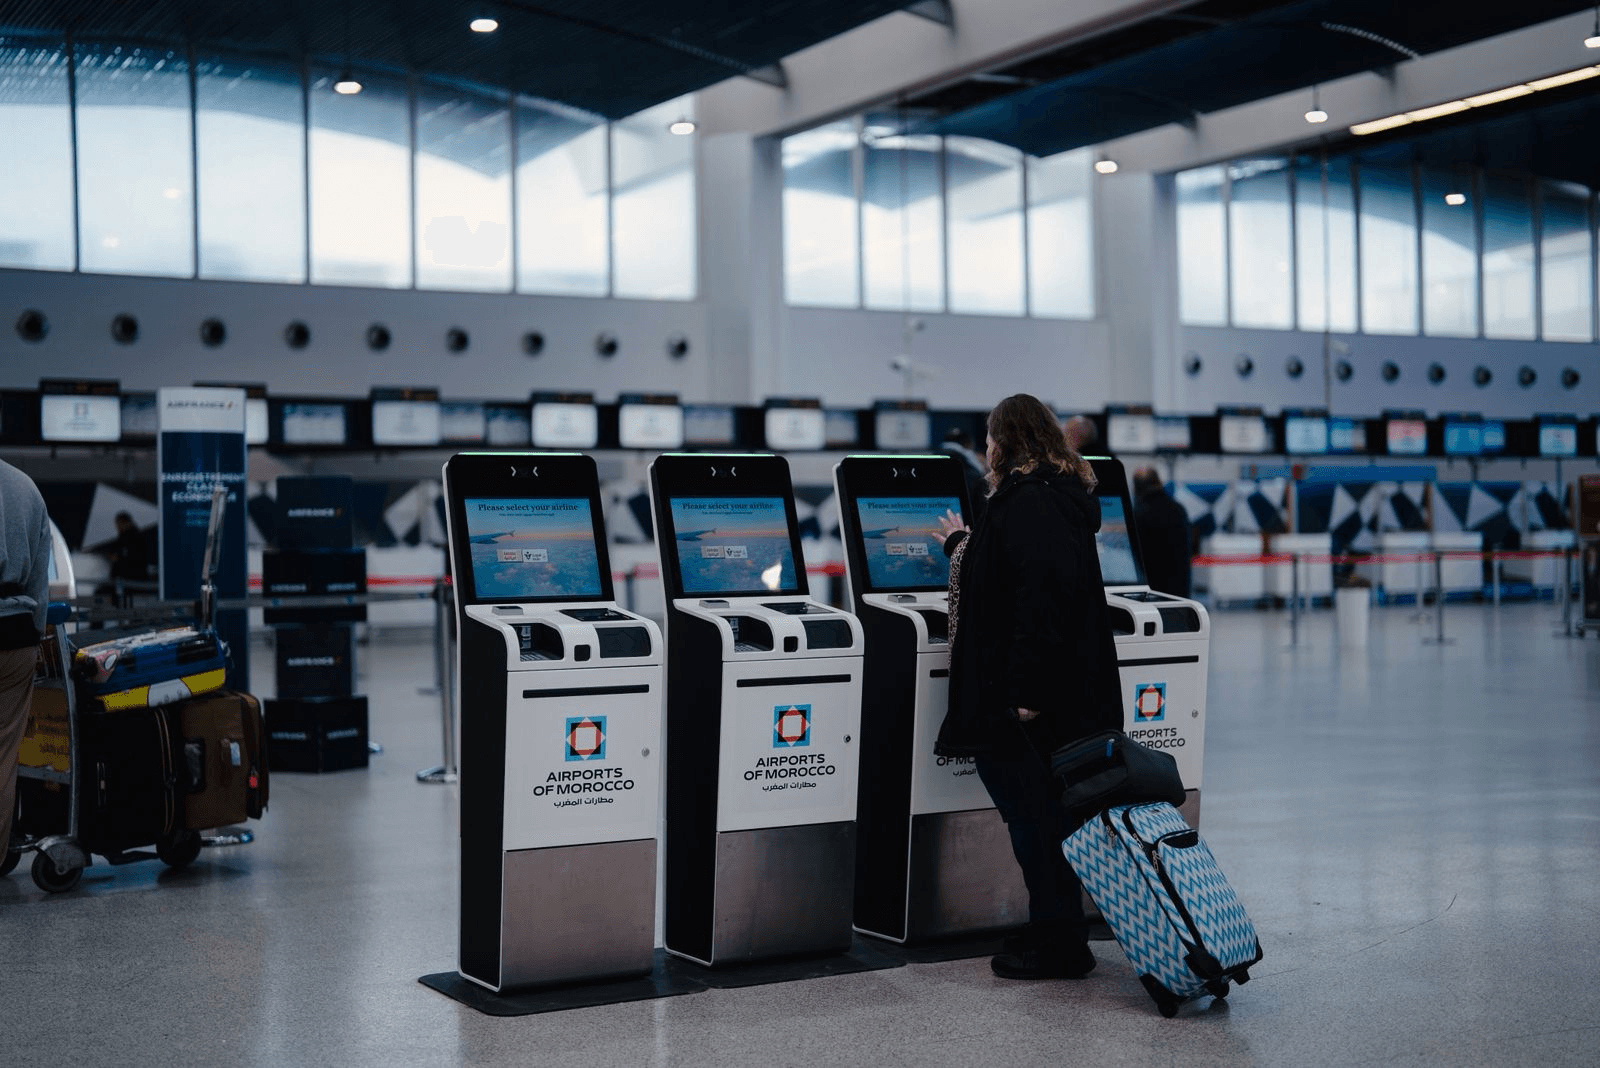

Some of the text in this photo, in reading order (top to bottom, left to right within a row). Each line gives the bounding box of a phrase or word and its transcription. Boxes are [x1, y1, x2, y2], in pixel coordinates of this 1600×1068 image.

[478, 503, 578, 512] Please select your airline
[682, 502, 774, 511] Please select your airline
[1127, 727, 1178, 739] IRPORTS
[755, 753, 826, 768] AIRPORTS
[936, 756, 954, 767] OF
[546, 767, 623, 783] AIRPORTS
[743, 764, 836, 781] OF MOROCCO
[533, 779, 635, 796] OF MOROCCO
[762, 781, 817, 792] مطارات المغرب
[553, 797, 614, 808] مطارات المغرب
